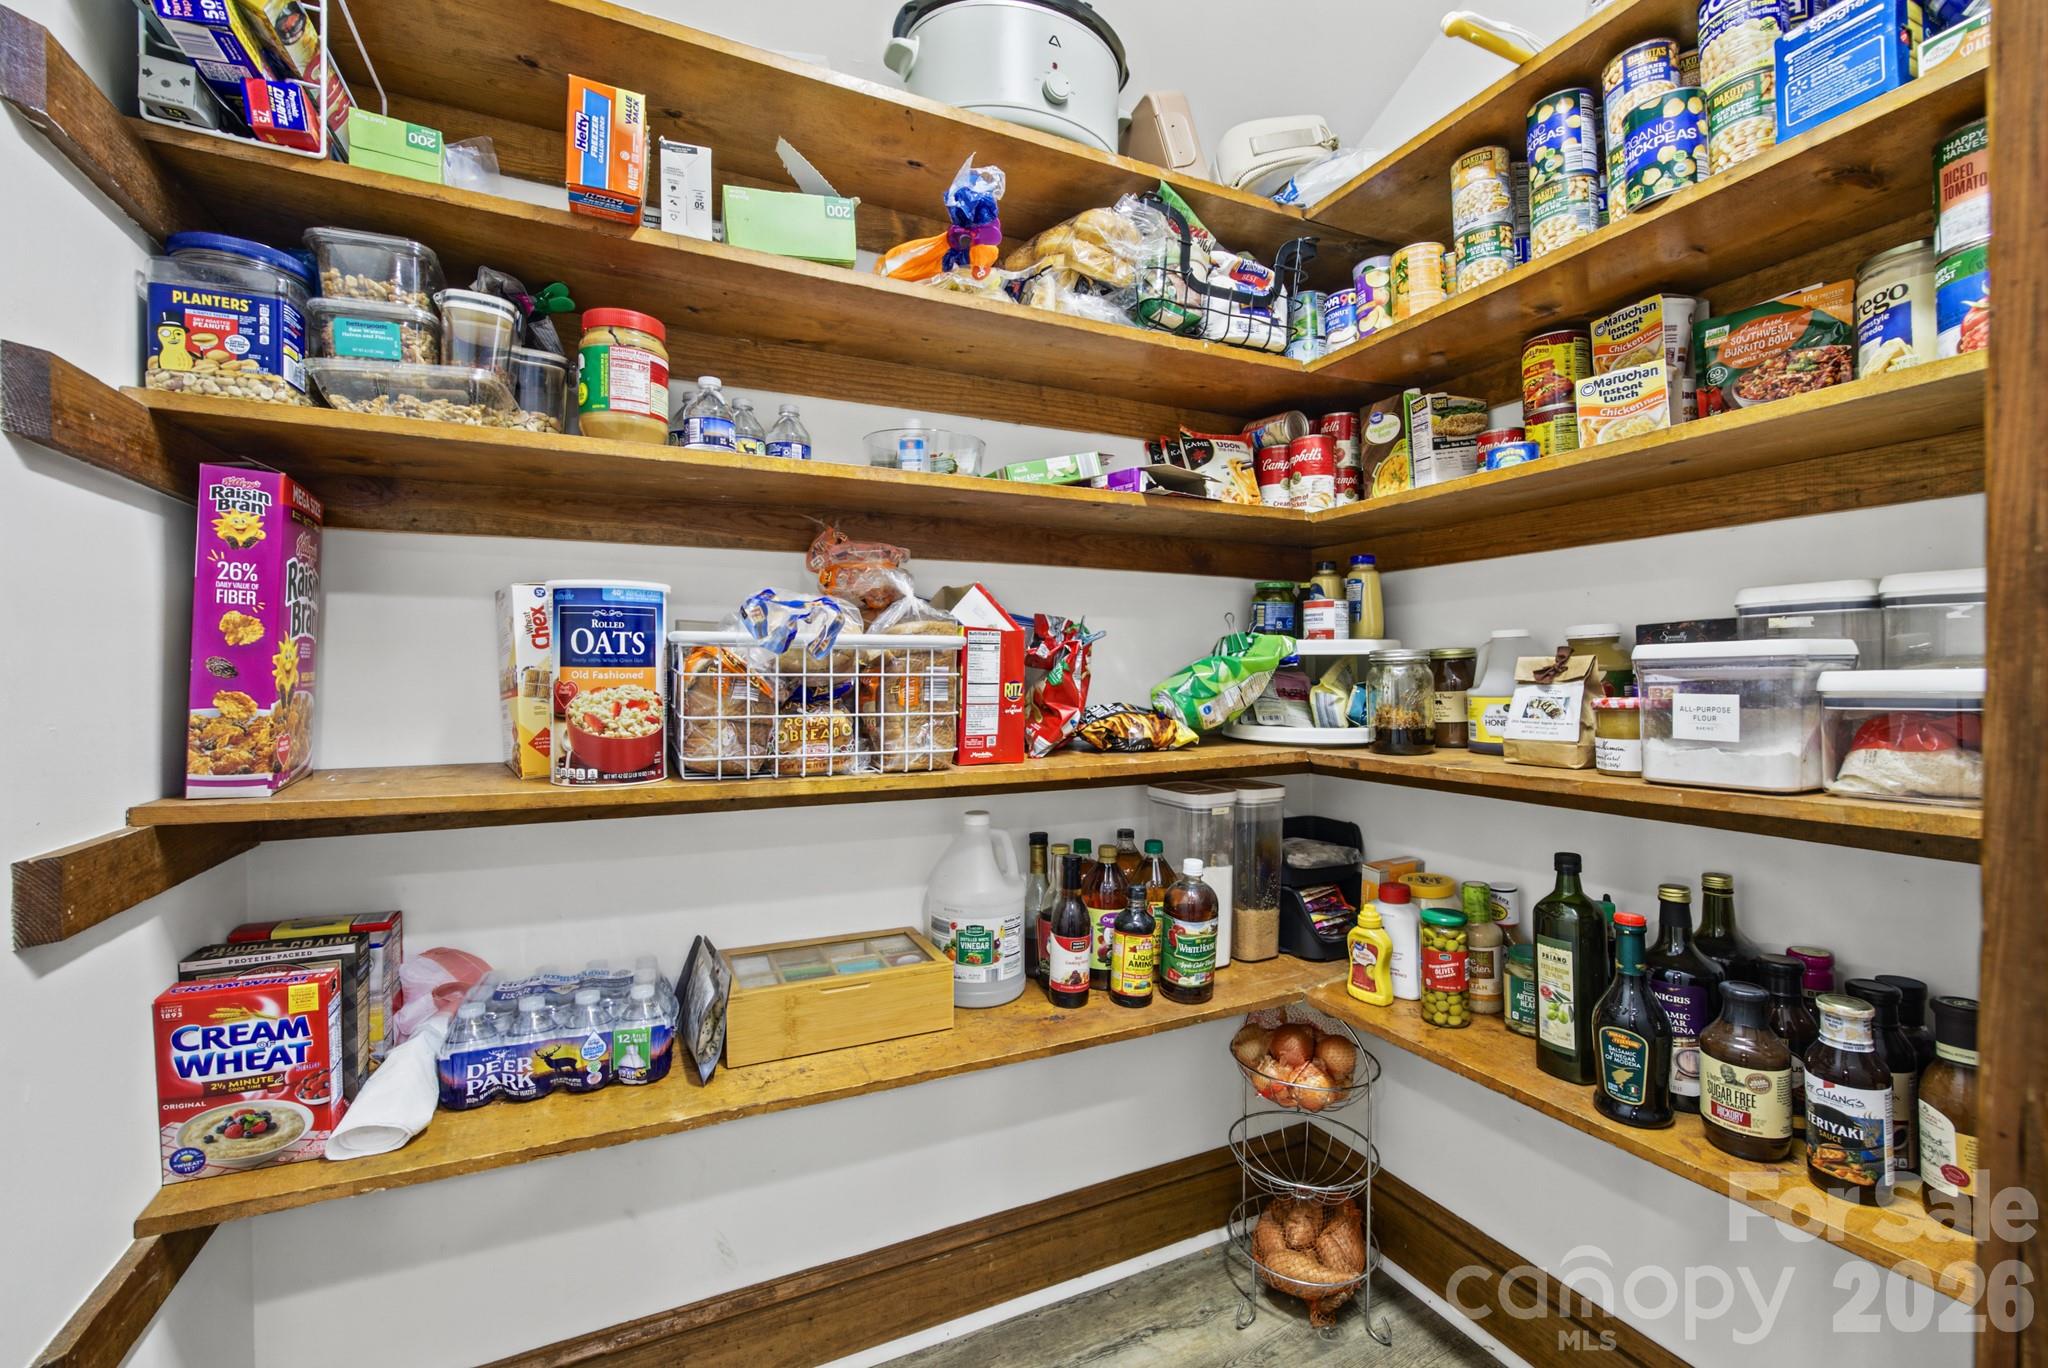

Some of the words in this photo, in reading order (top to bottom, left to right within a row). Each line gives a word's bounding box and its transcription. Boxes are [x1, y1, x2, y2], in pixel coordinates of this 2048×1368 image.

[625, 95, 633, 125] VALUE
[408, 132, 436, 149] 200
[576, 114, 590, 150] Hefty
[1623, 120, 1675, 151] RGANIC
[1945, 128, 1985, 152] HAPPY
[1625, 127, 1697, 166] HICKPEAS
[1942, 136, 1989, 162] HARVES
[1943, 162, 1974, 188] DICED
[1944, 172, 1987, 203] TOMATO
[827, 204, 851, 218] 200
[172, 289, 249, 313] PLANTERS
[1857, 283, 1909, 316] rego
[1604, 301, 1657, 328] Maruchan
[192, 321, 231, 331] PEANUTS
[1607, 316, 1643, 335] Instant
[1611, 327, 1640, 341] Lunch
[1730, 322, 1790, 346] SOUTHWEST
[1609, 336, 1643, 354] Chicken
[1768, 331, 1796, 346] BOWL
[1724, 340, 1765, 358] BURRITO
[1593, 366, 1659, 388] Maruchan
[1599, 380, 1643, 396] Instant
[1604, 391, 1639, 404] Lunch
[1600, 401, 1643, 418] Chicken
[1216, 441, 1241, 451] UDON
[210, 485, 272, 506] Raisin
[216, 498, 266, 516] Bran
[217, 561, 258, 582] 26%
[216, 590, 257, 605] FIBER
[530, 605, 550, 650] Chex
[570, 627, 646, 656] OATS
[571, 670, 589, 679] Old
[592, 670, 644, 680] Fashioned
[1004, 681, 1024, 698] RITZ
[1680, 705, 1732, 714] ALL-PURPOSE
[1692, 714, 1717, 722] FLOUR
[960, 941, 990, 950] VINEGAR
[228, 950, 313, 965] PROTEIN-PACKED
[1542, 952, 1567, 964] PRIANO
[1435, 967, 1455, 975] OLIVES
[1655, 991, 1691, 1005] NIGRIS
[160, 1012, 183, 1020] 1893
[1666, 1012, 1691, 1021] AMIC
[171, 1016, 311, 1051] CREAM
[617, 1034, 630, 1043] 12
[257, 1040, 276, 1049] OF
[1608, 1045, 1636, 1058] BALSAMIC
[173, 1041, 312, 1079] WHEAT
[1610, 1050, 1636, 1062] VINEGAR
[1614, 1057, 1641, 1069] MODENA
[466, 1057, 534, 1080] DEER
[229, 1075, 275, 1088] MINUTE
[466, 1072, 537, 1097] PARK
[1707, 1080, 1732, 1102] SUGAR
[1734, 1090, 1757, 1109] FREE
[163, 1101, 207, 1110] ORIGINAL
[1807, 1110, 1865, 1141] TERIYAKI
[1818, 1130, 1842, 1144] SAUCE
